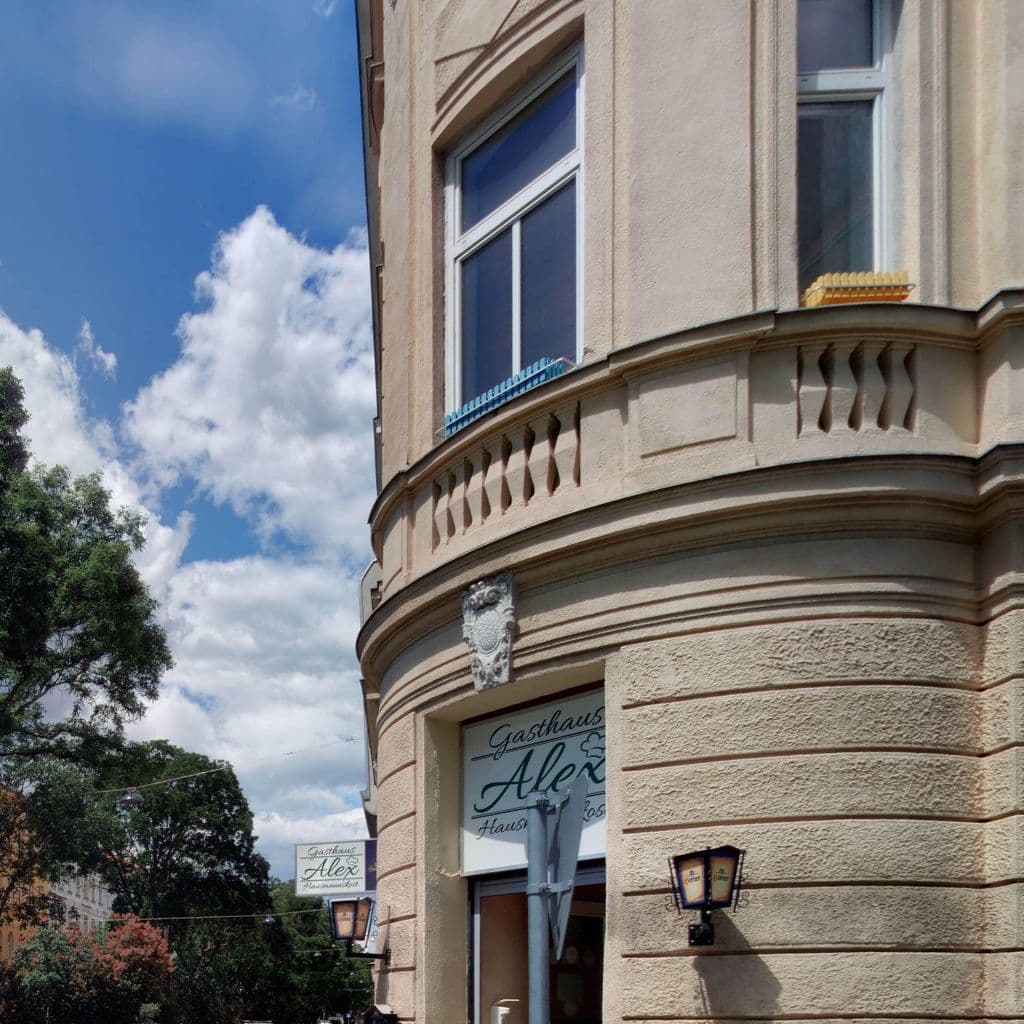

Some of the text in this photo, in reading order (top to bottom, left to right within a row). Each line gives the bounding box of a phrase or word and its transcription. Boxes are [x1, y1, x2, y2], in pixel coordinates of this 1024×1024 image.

[488, 706, 605, 760] Gasthaus
[473, 742, 606, 813] Alex
[301, 857, 359, 880] Alex
[307, 845, 357, 860] Gasthaus
